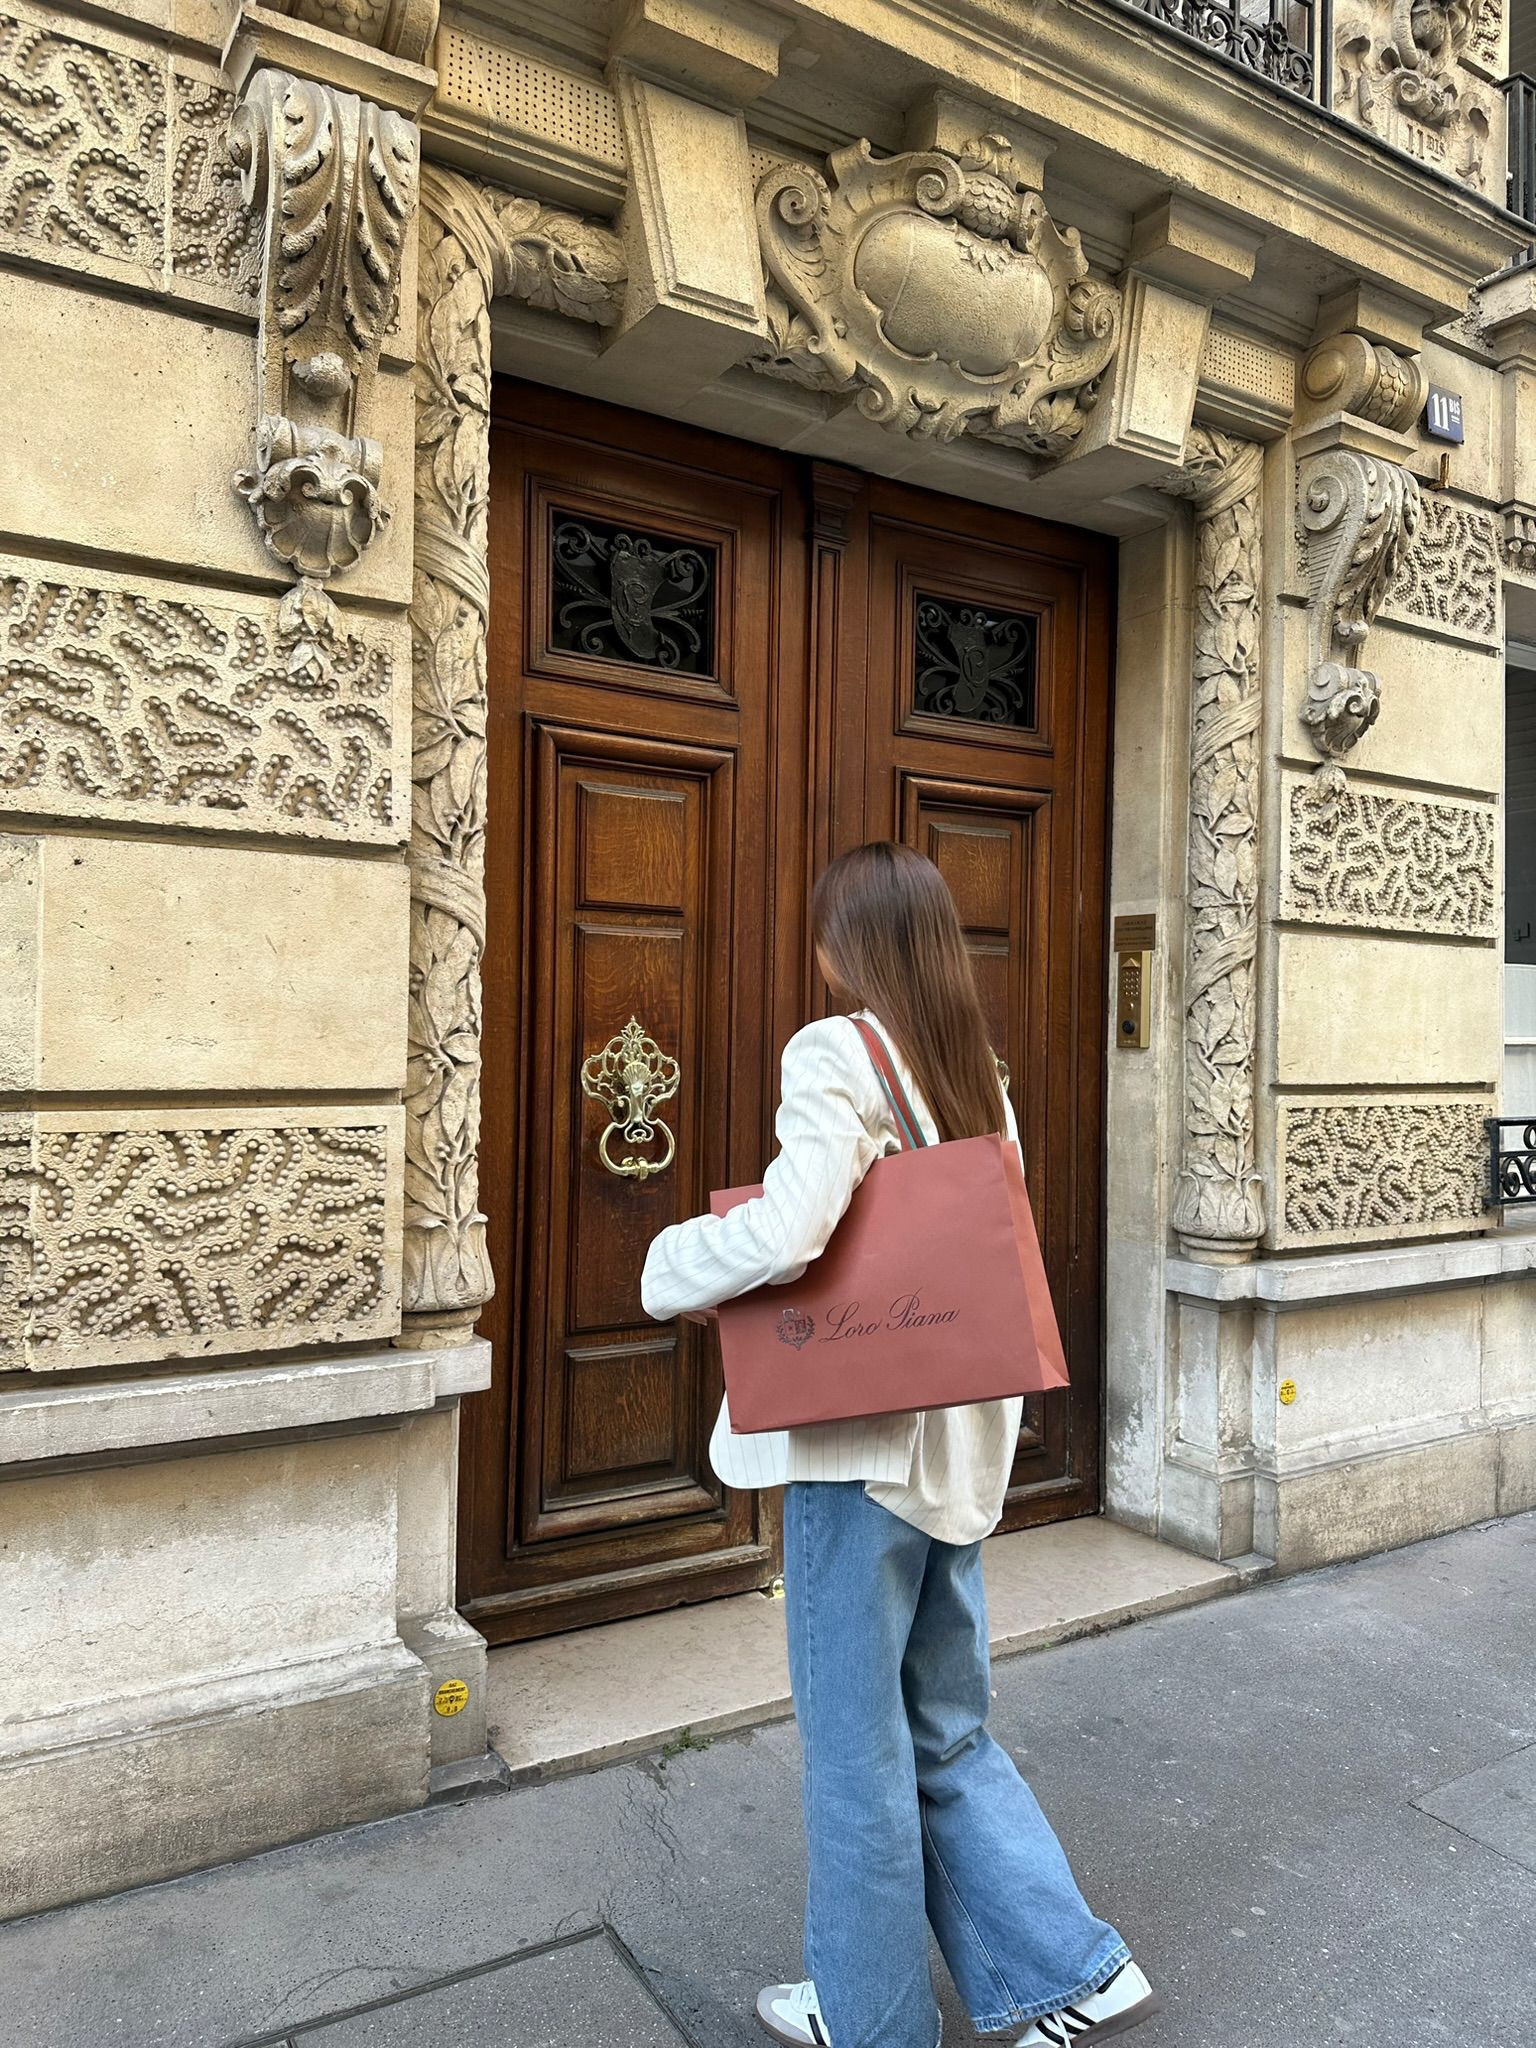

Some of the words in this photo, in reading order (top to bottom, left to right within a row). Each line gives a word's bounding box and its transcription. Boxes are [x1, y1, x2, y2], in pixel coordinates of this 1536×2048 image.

[1432, 393, 1450, 432] 11
[818, 1301, 883, 1343] Loro
[886, 1286, 961, 1331] Piana
